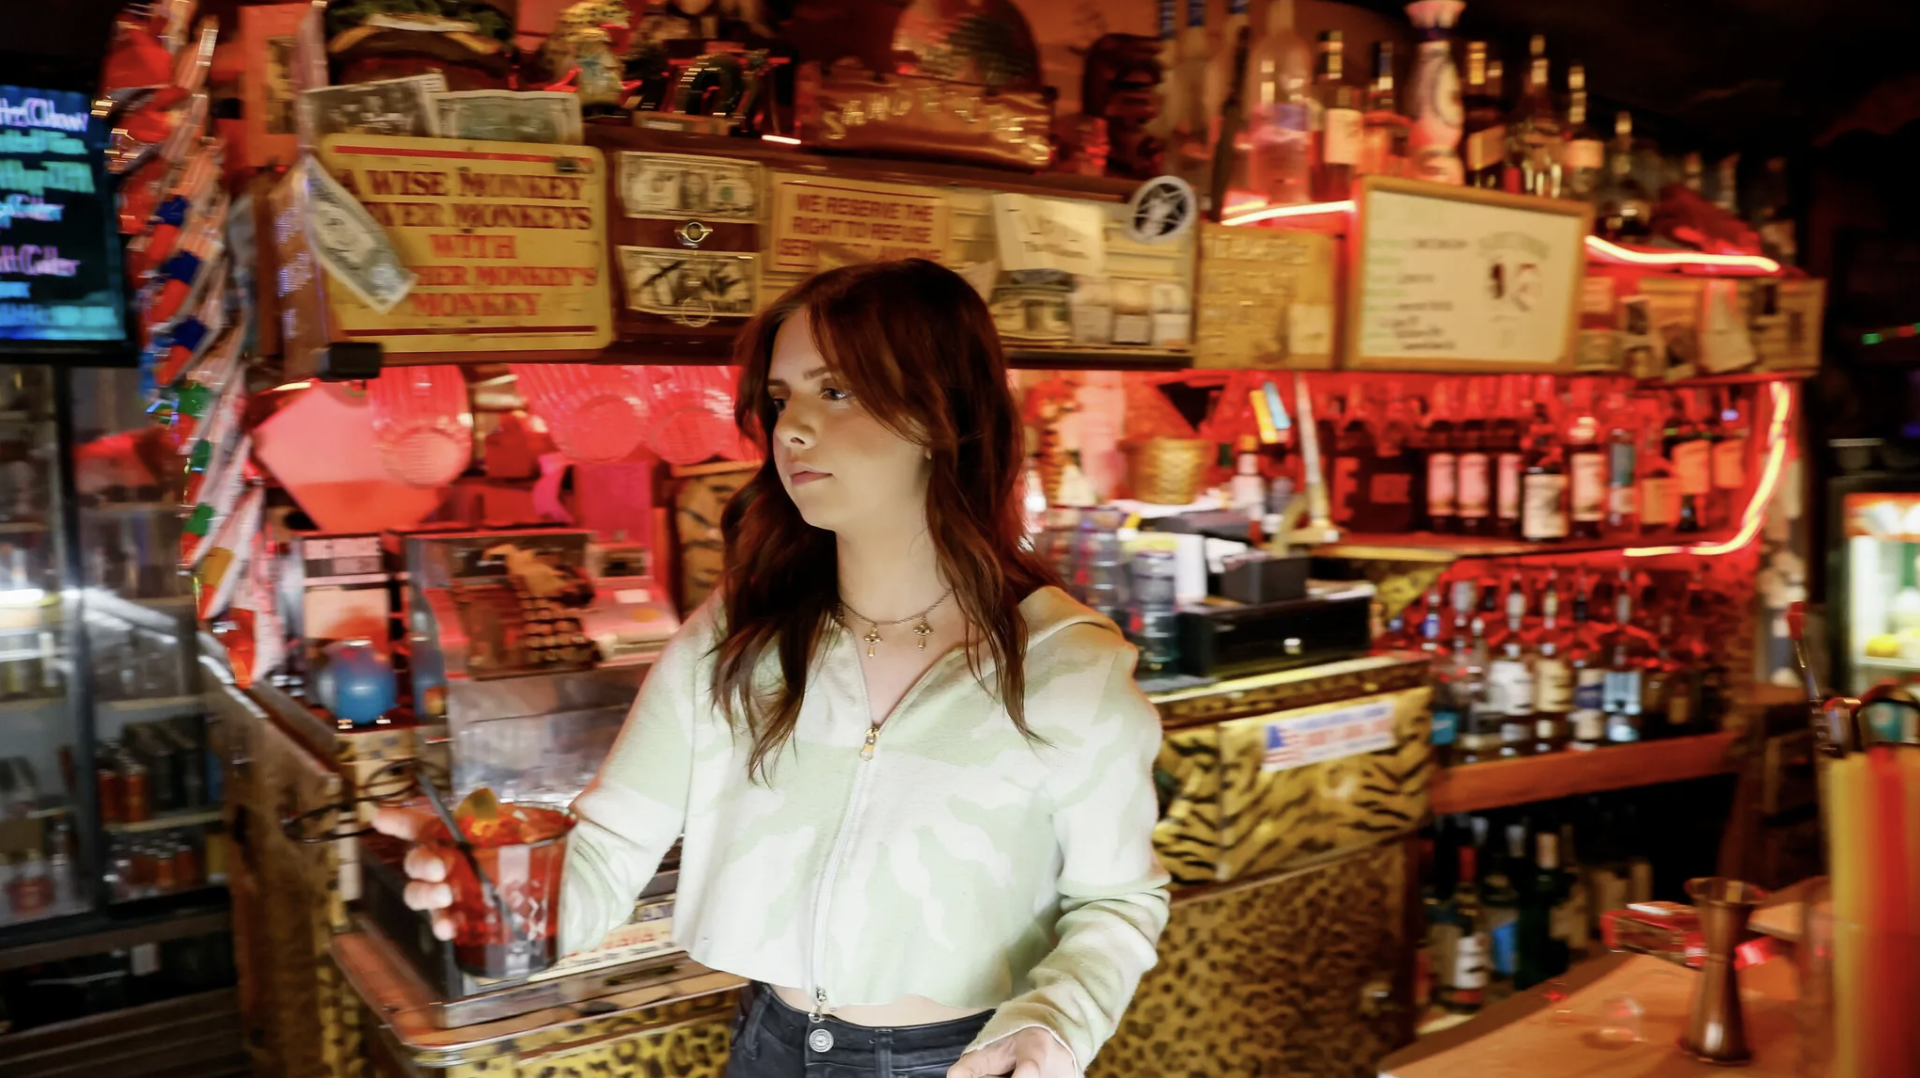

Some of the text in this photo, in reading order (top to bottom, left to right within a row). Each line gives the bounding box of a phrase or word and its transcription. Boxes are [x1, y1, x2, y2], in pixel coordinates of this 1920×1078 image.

[365, 170, 448, 196] WISE
[457, 171, 586, 200] MONKEY
[452, 203, 592, 230] MONKEYS
[797, 194, 934, 223] WE RESERVE THE
[793, 216, 845, 236] RIGHT
[845, 219, 870, 239] TO
[429, 234, 518, 259] WITH
[473, 265, 598, 287] MONKEY'S
[410, 293, 540, 316] MONKEY
